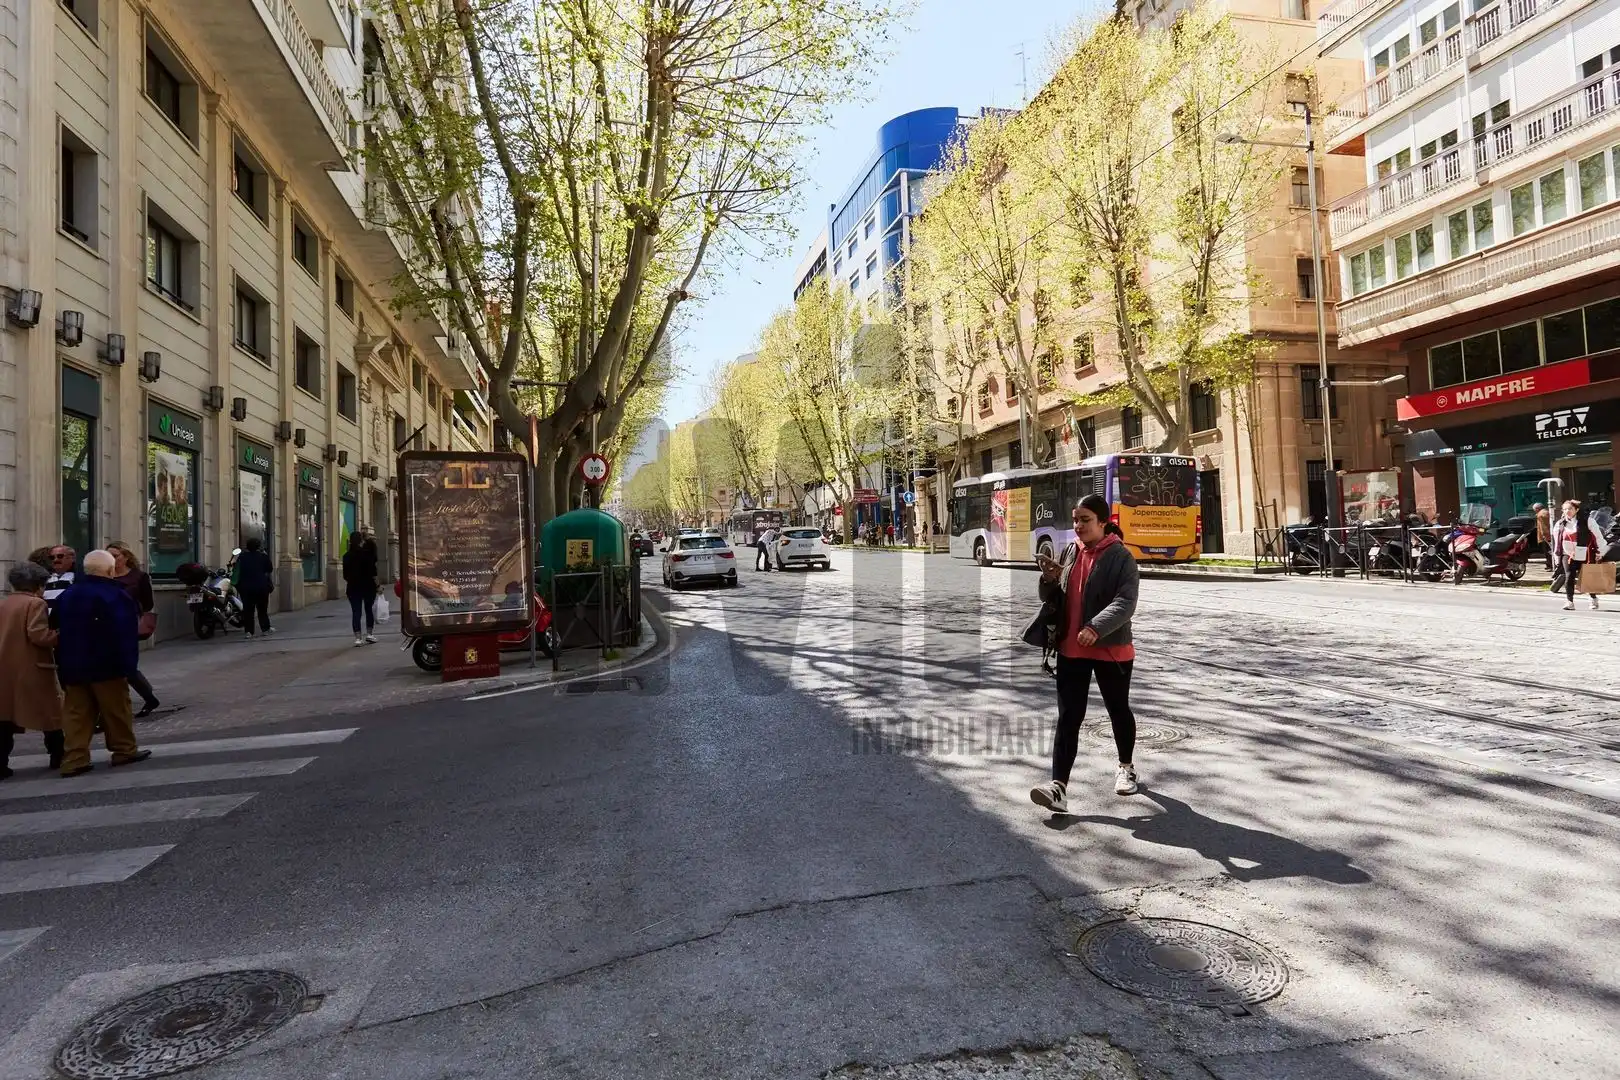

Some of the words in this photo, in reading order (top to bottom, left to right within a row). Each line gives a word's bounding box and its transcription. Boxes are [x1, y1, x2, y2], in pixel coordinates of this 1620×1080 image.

[1456, 376, 1535, 404] MAPFRE
[1535, 406, 1590, 431] PTV
[171, 423, 195, 444] Unicaja
[1536, 426, 1587, 440] TELECOM
[253, 454, 269, 470] Unicaja
[1151, 456, 1161, 467] 13
[1169, 458, 1188, 466] alsa
[955, 487, 967, 497] alsa
[1043, 509, 1054, 518] Eco
